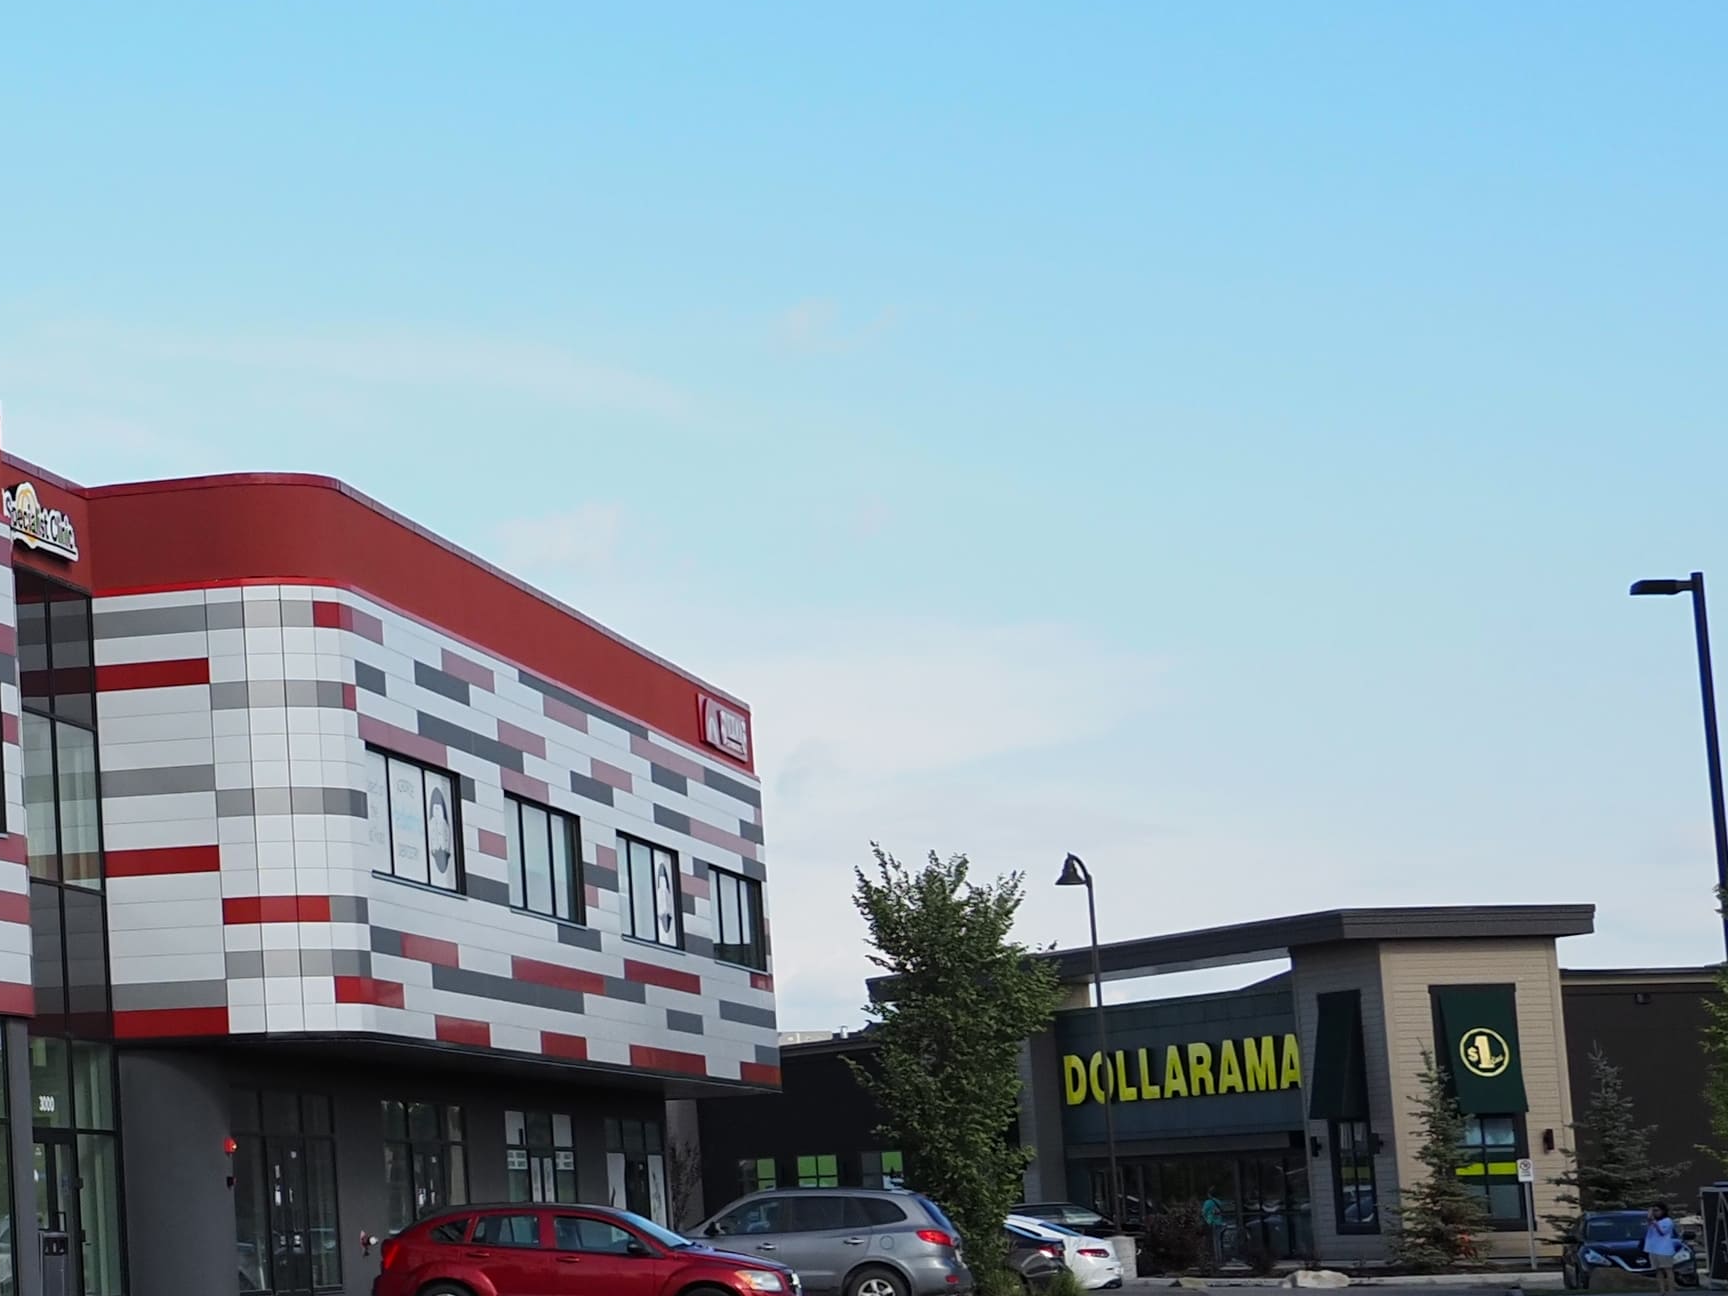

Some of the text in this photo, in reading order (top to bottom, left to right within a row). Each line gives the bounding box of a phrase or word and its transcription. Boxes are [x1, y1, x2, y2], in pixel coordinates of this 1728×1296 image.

[5, 496, 74, 549] Specialist Clinic
[1063, 1033, 1302, 1105] DOLLARAMA
[38, 1095, 55, 1112] 3000
